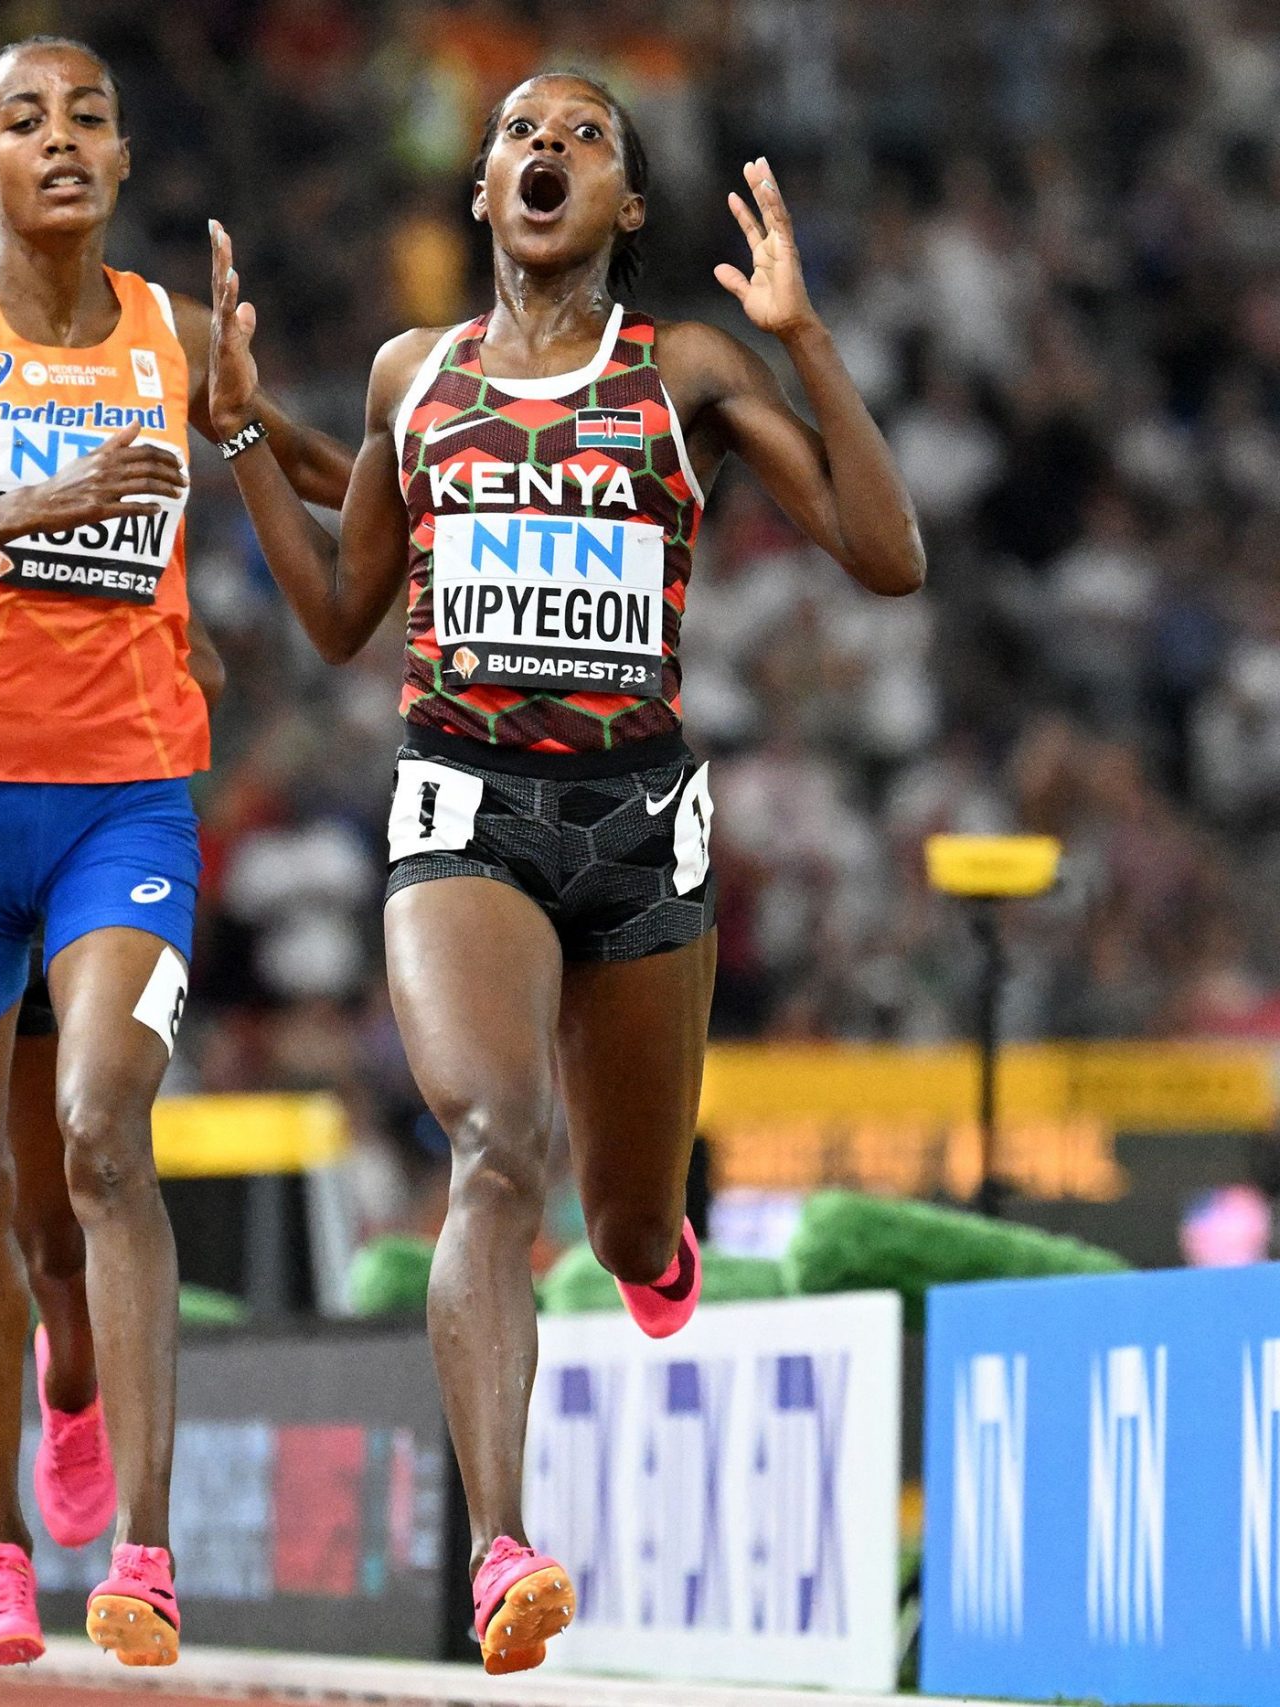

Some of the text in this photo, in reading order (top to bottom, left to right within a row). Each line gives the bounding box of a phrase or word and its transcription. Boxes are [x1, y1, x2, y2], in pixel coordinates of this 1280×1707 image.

[48, 364, 117, 377] NEDERLANDSE
[10, 426, 105, 480] NT
[429, 461, 638, 510] KENYA
[470, 518, 624, 582] NTN
[443, 584, 650, 645] KIPYEGON
